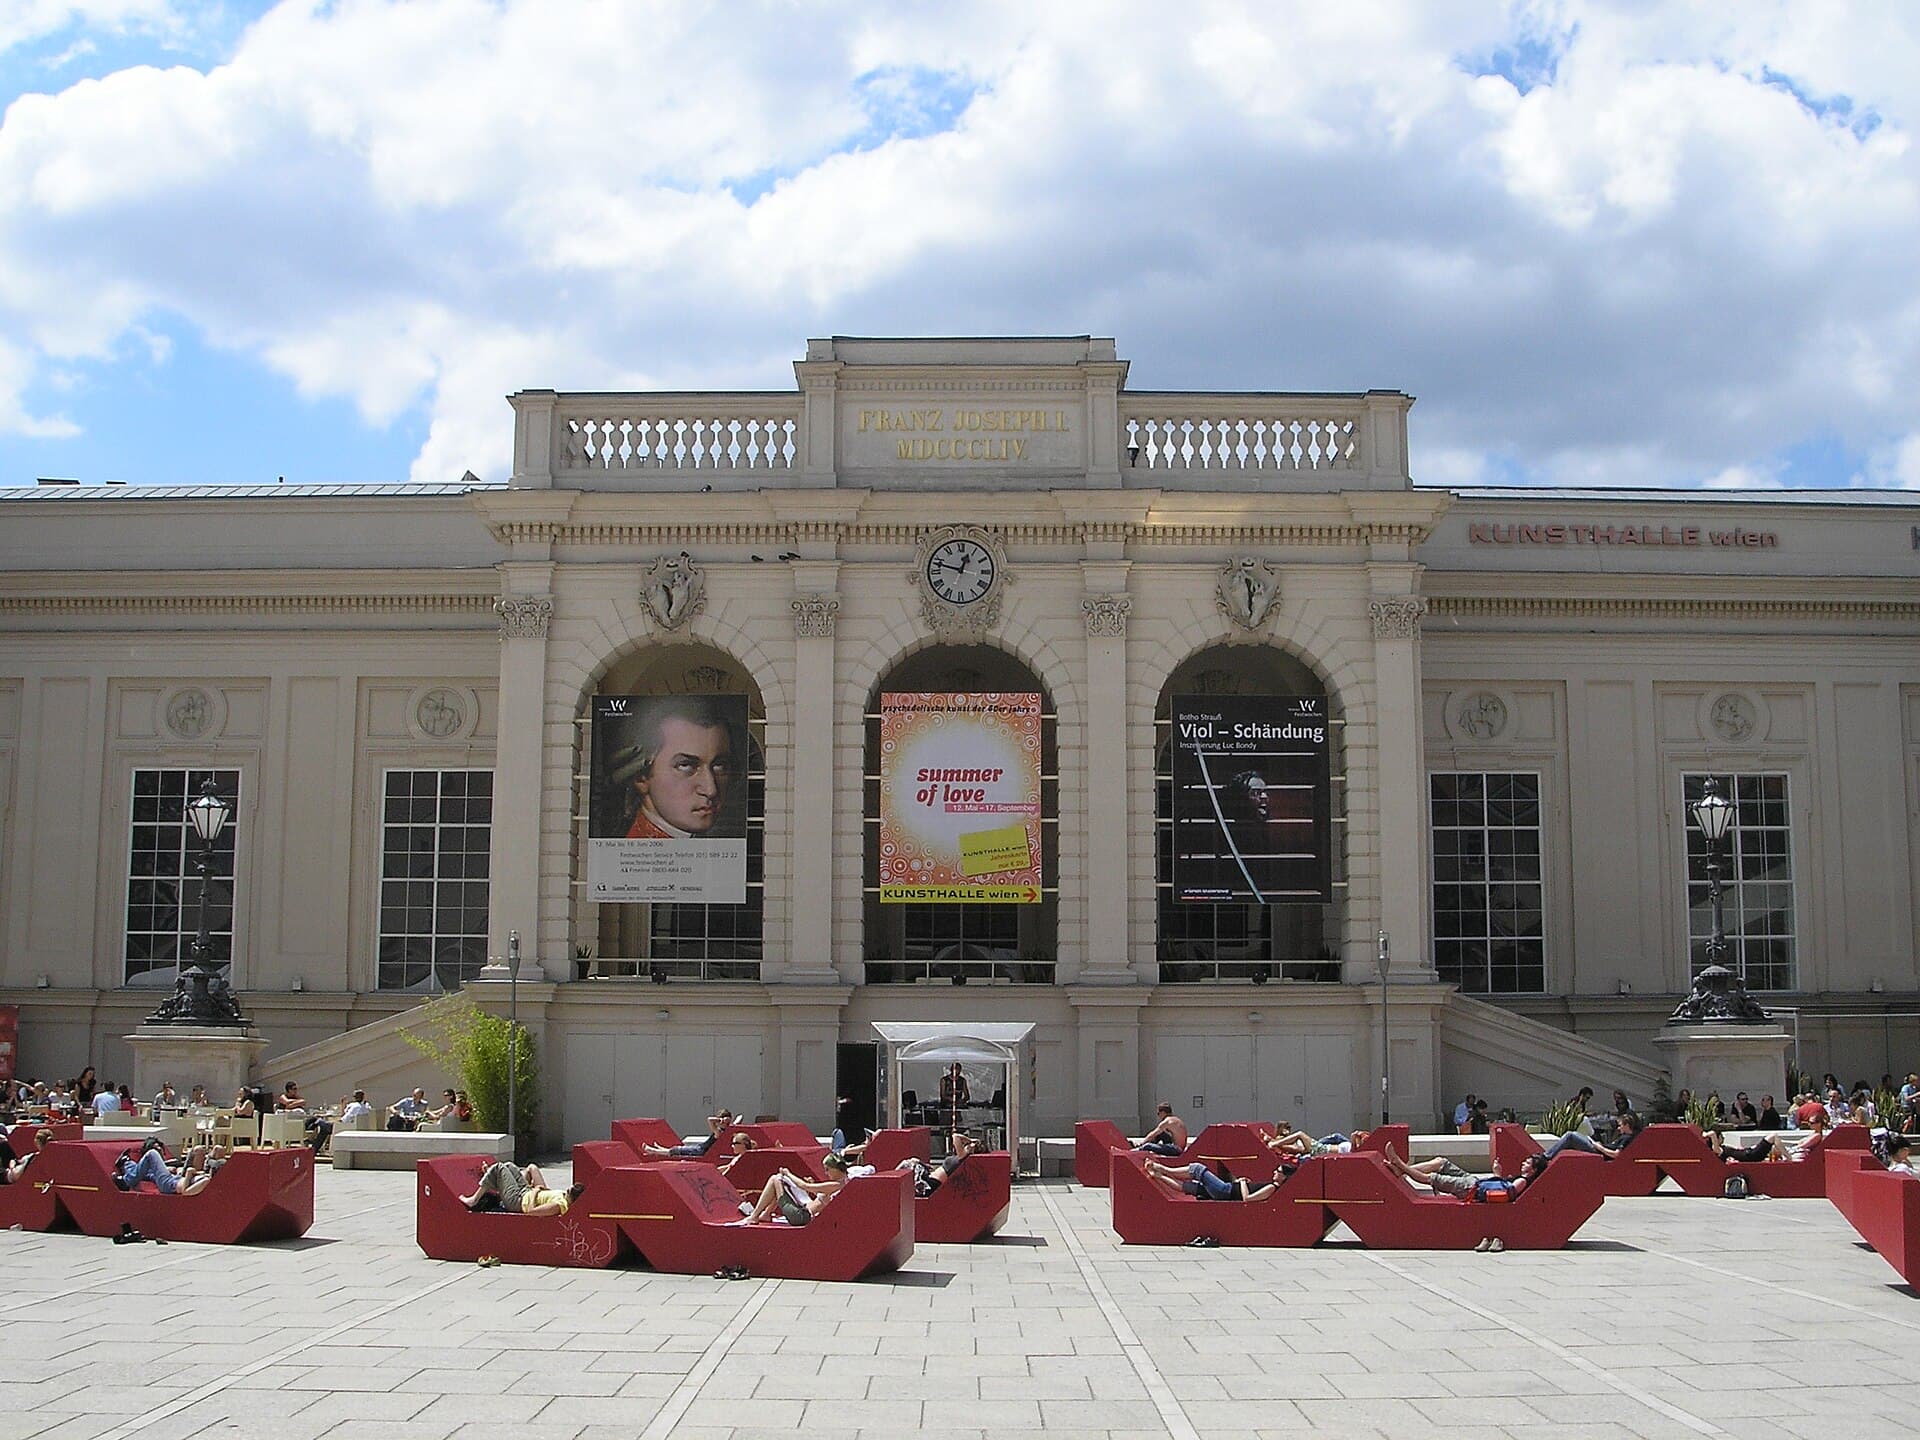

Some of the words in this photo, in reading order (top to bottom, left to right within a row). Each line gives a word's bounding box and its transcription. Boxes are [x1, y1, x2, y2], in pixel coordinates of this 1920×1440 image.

[857, 409, 944, 433] FRANZ
[952, 409, 1047, 433] JOSEPH
[1468, 522, 1700, 547] KUNSTHALLE
[1708, 526, 1778, 548] wien
[973, 704, 986, 713] der
[1179, 713, 1200, 721] Botho
[1179, 722, 1213, 739] Viol
[1233, 722, 1325, 743] Schändung
[1222, 741, 1235, 749] Luc
[1235, 741, 1257, 750] Bondy
[916, 767, 1004, 783] summer
[916, 783, 938, 806] of
[943, 784, 986, 803] love
[964, 804, 979, 812] Mai
[997, 804, 1037, 814] September
[962, 847, 1009, 857] KUNSTHALLE
[883, 888, 985, 899] KUNSTHALLE
[988, 889, 1020, 899] wien
